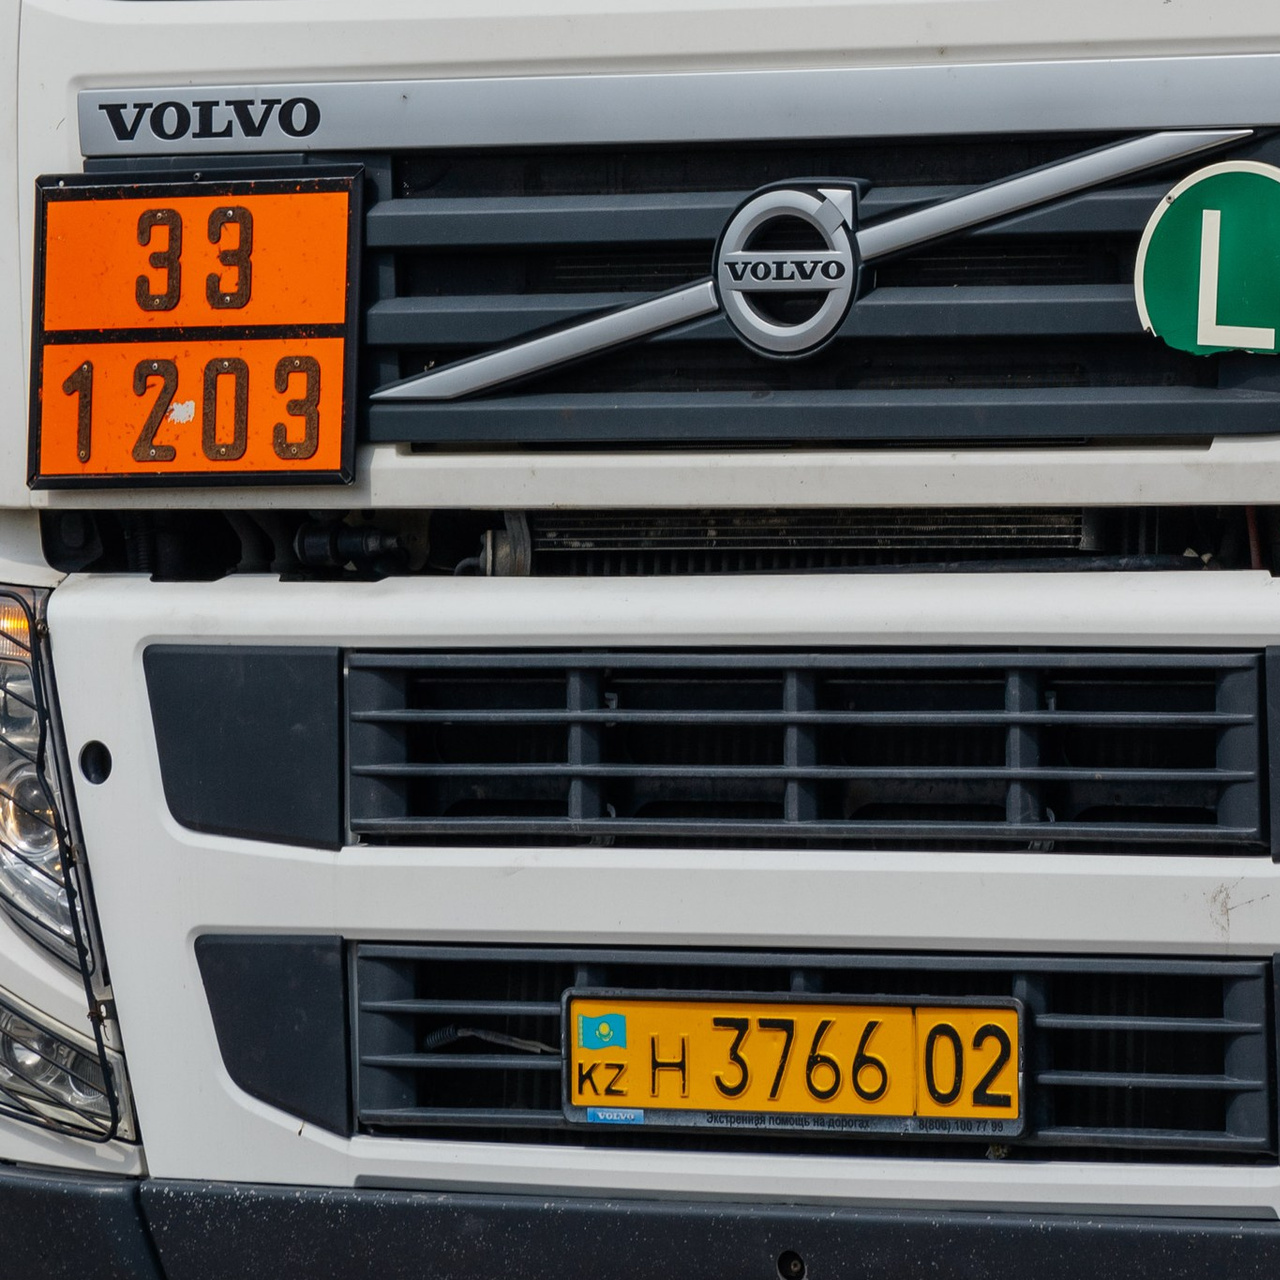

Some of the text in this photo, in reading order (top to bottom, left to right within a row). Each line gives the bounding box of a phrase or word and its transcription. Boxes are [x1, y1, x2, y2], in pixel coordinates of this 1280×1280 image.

[98, 96, 321, 141] VOLVO
[134, 206, 254, 312] 33
[724, 259, 846, 284] VOLVO
[1197, 208, 1276, 350] L
[61, 356, 321, 463] 1203
[577, 1061, 628, 1096] KZ
[650, 1016, 1013, 1108] H 3766 02
[596, 1111, 635, 1120] VOLVO
[706, 1111, 870, 1129] Экстренная помощь на дорогах
[918, 1118, 1004, 1133] 8(800) 100 77 99
